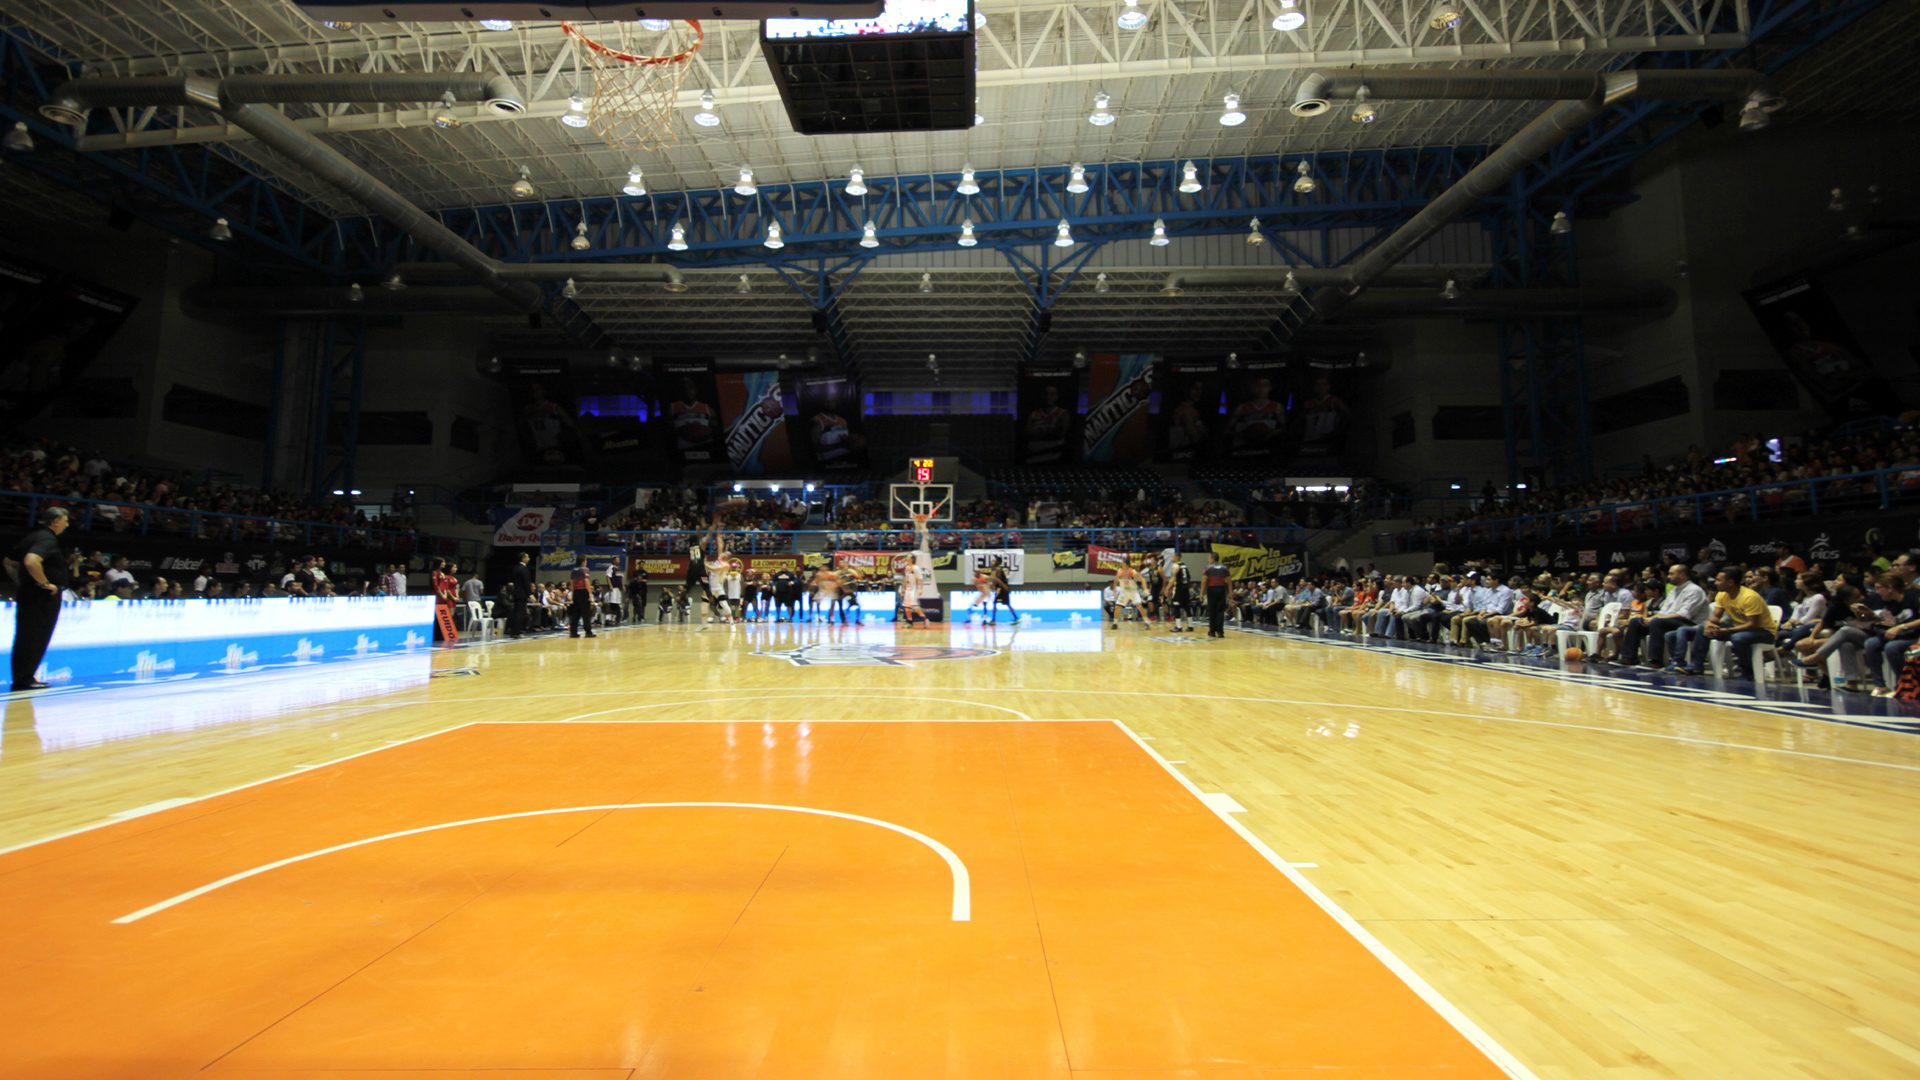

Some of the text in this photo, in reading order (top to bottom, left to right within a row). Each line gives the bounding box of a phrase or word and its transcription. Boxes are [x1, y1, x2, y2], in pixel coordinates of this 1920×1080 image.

[497, 533, 526, 544] Dairy
[876, 555, 890, 567] TU
[972, 553, 1020, 572] FINAL
[1249, 554, 1297, 577] Mejor
